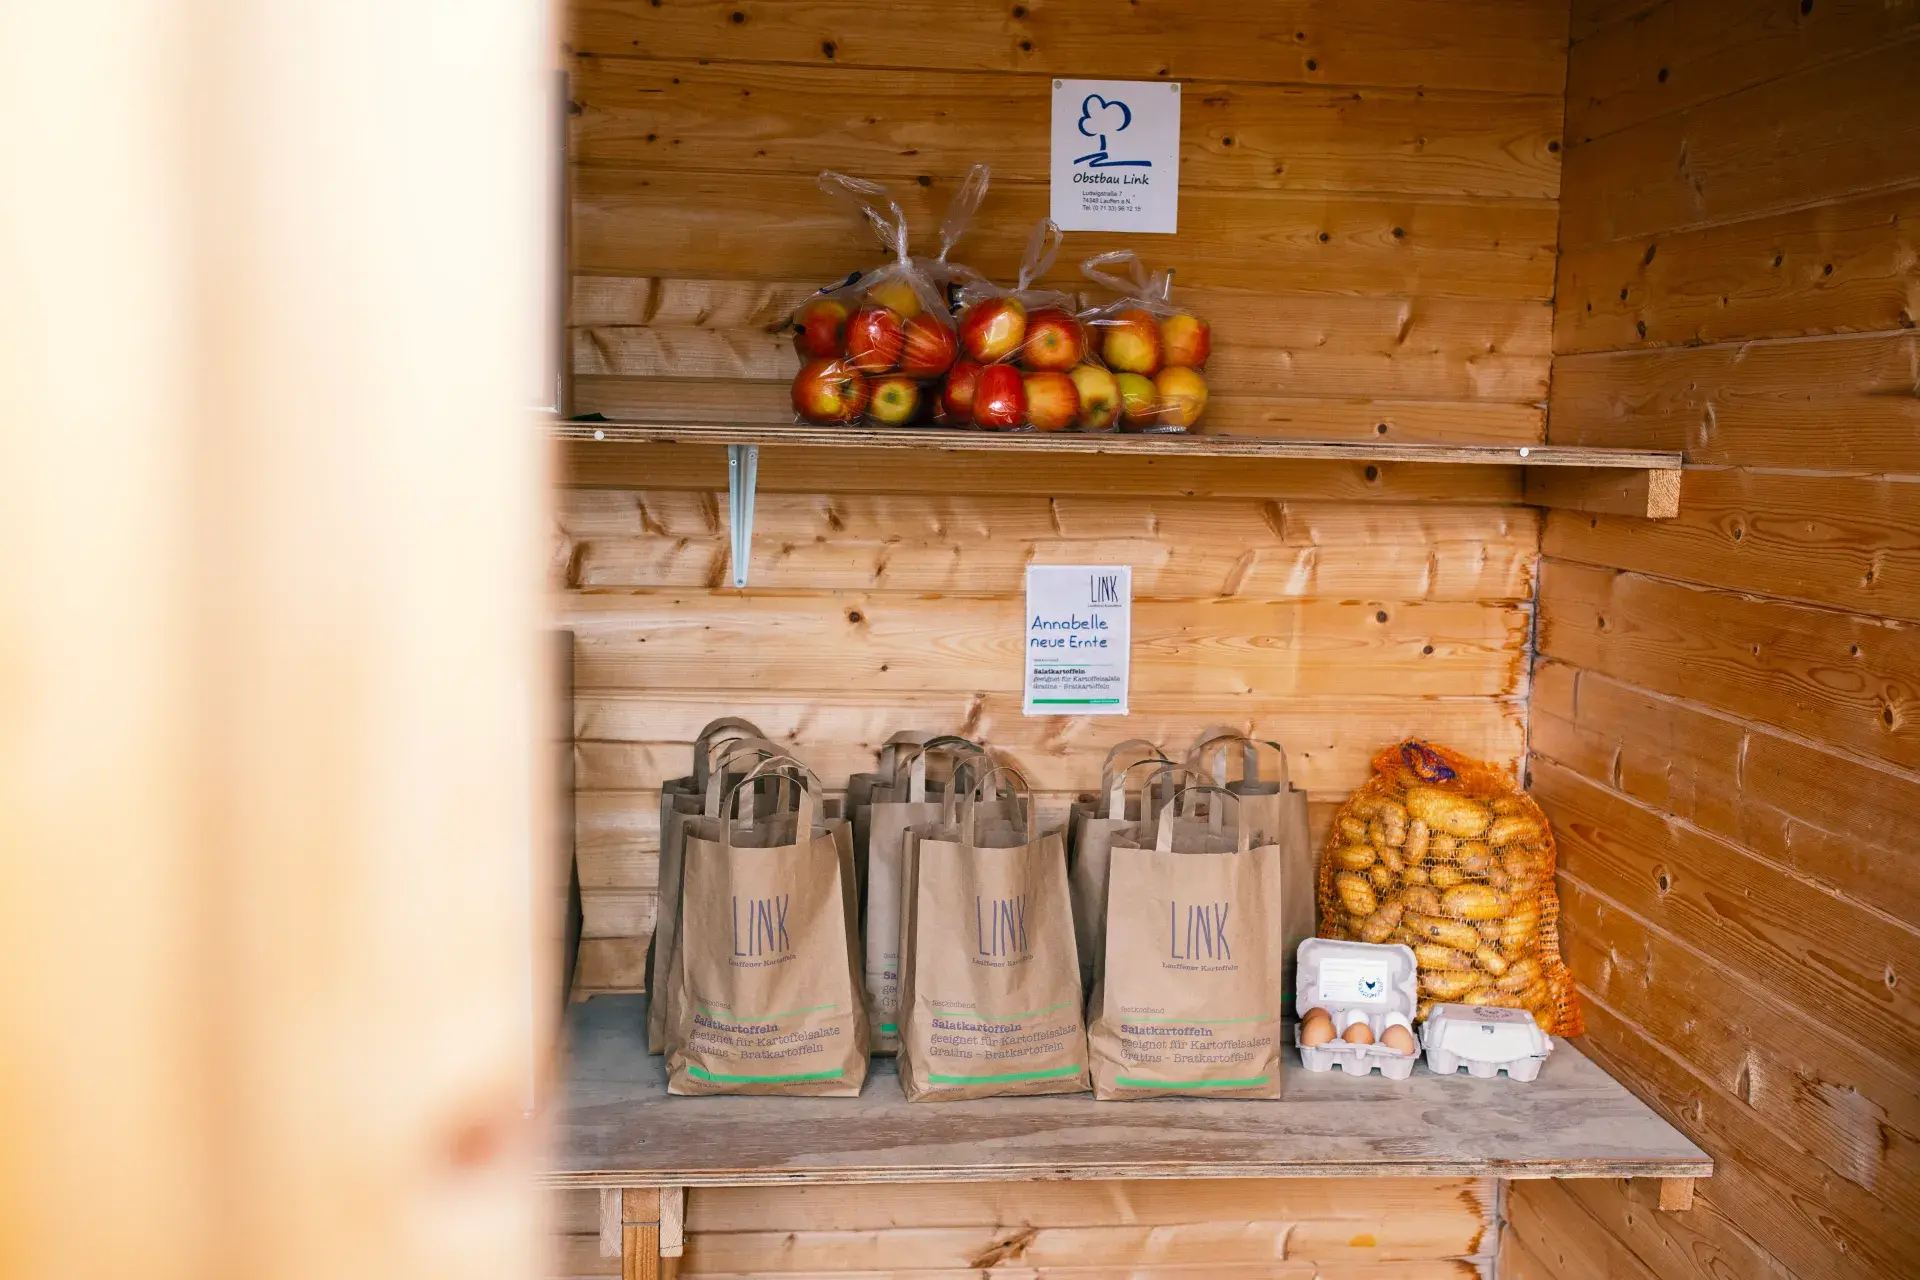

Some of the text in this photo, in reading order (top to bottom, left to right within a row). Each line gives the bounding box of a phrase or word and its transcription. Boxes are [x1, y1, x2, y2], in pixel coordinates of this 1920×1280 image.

[1073, 171, 1149, 185] Obstbau Link
[1090, 574, 1119, 603] LINK
[1031, 613, 1109, 630] Annabelle
[1030, 635, 1108, 648] neue Ernte
[732, 893, 790, 957] LINK
[976, 894, 1028, 957] LINK
[1171, 901, 1231, 961] LINK
[727, 953, 797, 969] Lauffener Kartoffeln
[972, 957, 1006, 968] Lauffener
[1162, 961, 1239, 972] Lauffener Kartoffeln
[693, 1014, 779, 1035] Salatkartoffeln
[931, 1019, 1023, 1034] Salatkartoffeln
[1121, 1024, 1213, 1037] Salatkartoffeln
[689, 1025, 841, 1047] geeignet für Kartoffelsalate
[930, 1022, 1077, 1047] geeignet für Kartoffelsalate
[688, 1041, 729, 1058] Gratins
[740, 1043, 824, 1060] Bratkartoffeln
[929, 1046, 973, 1059] Gratins
[984, 1041, 1064, 1060] Bratkartoffeln
[1121, 1036, 1271, 1051] geeignet für Kartoffelsalate
[1120, 1049, 1162, 1063] Gratins
[1173, 1051, 1255, 1064] Bratkartoffeln
